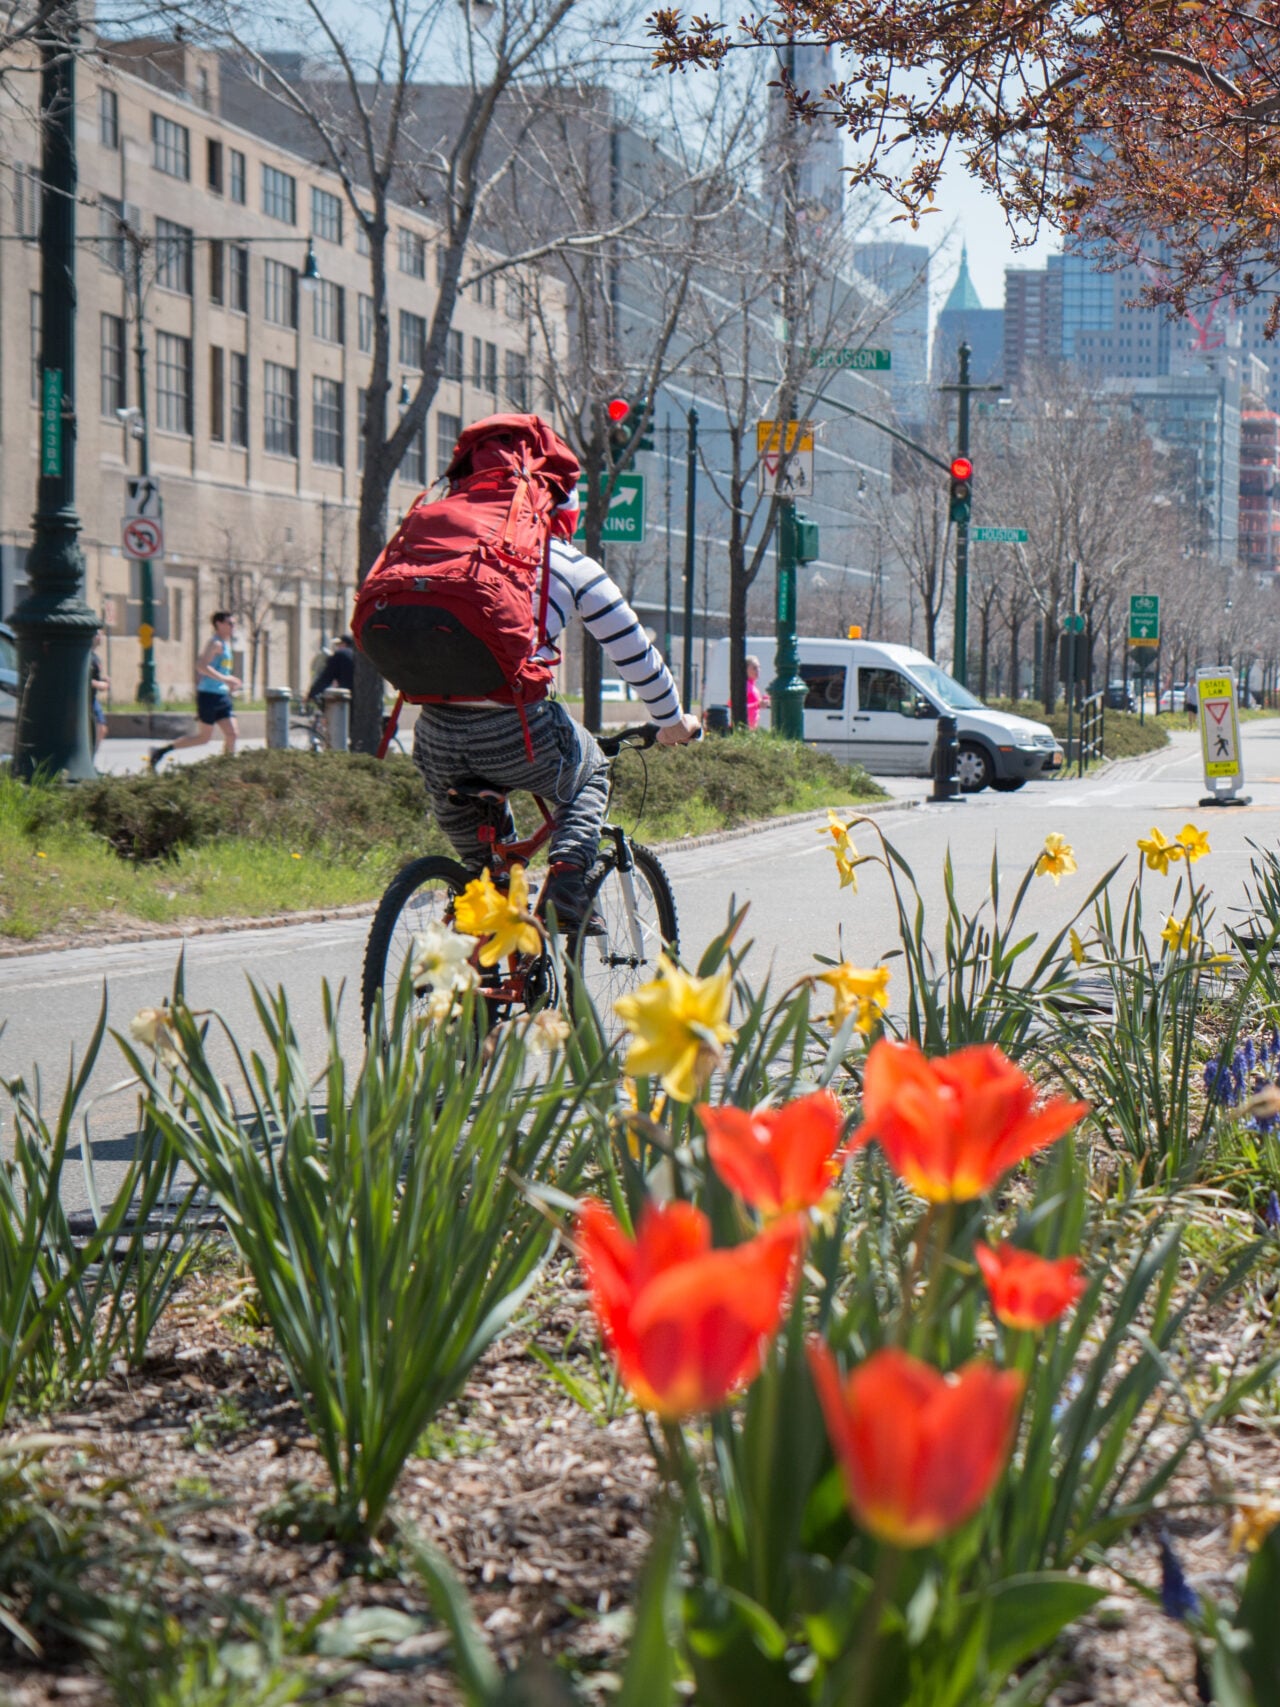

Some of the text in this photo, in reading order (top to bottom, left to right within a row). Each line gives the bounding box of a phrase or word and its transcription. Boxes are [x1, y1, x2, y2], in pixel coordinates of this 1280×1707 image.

[981, 528, 1019, 541] HOUSTON
[1205, 680, 1226, 688] STATE
[1208, 688, 1223, 696] LAW
